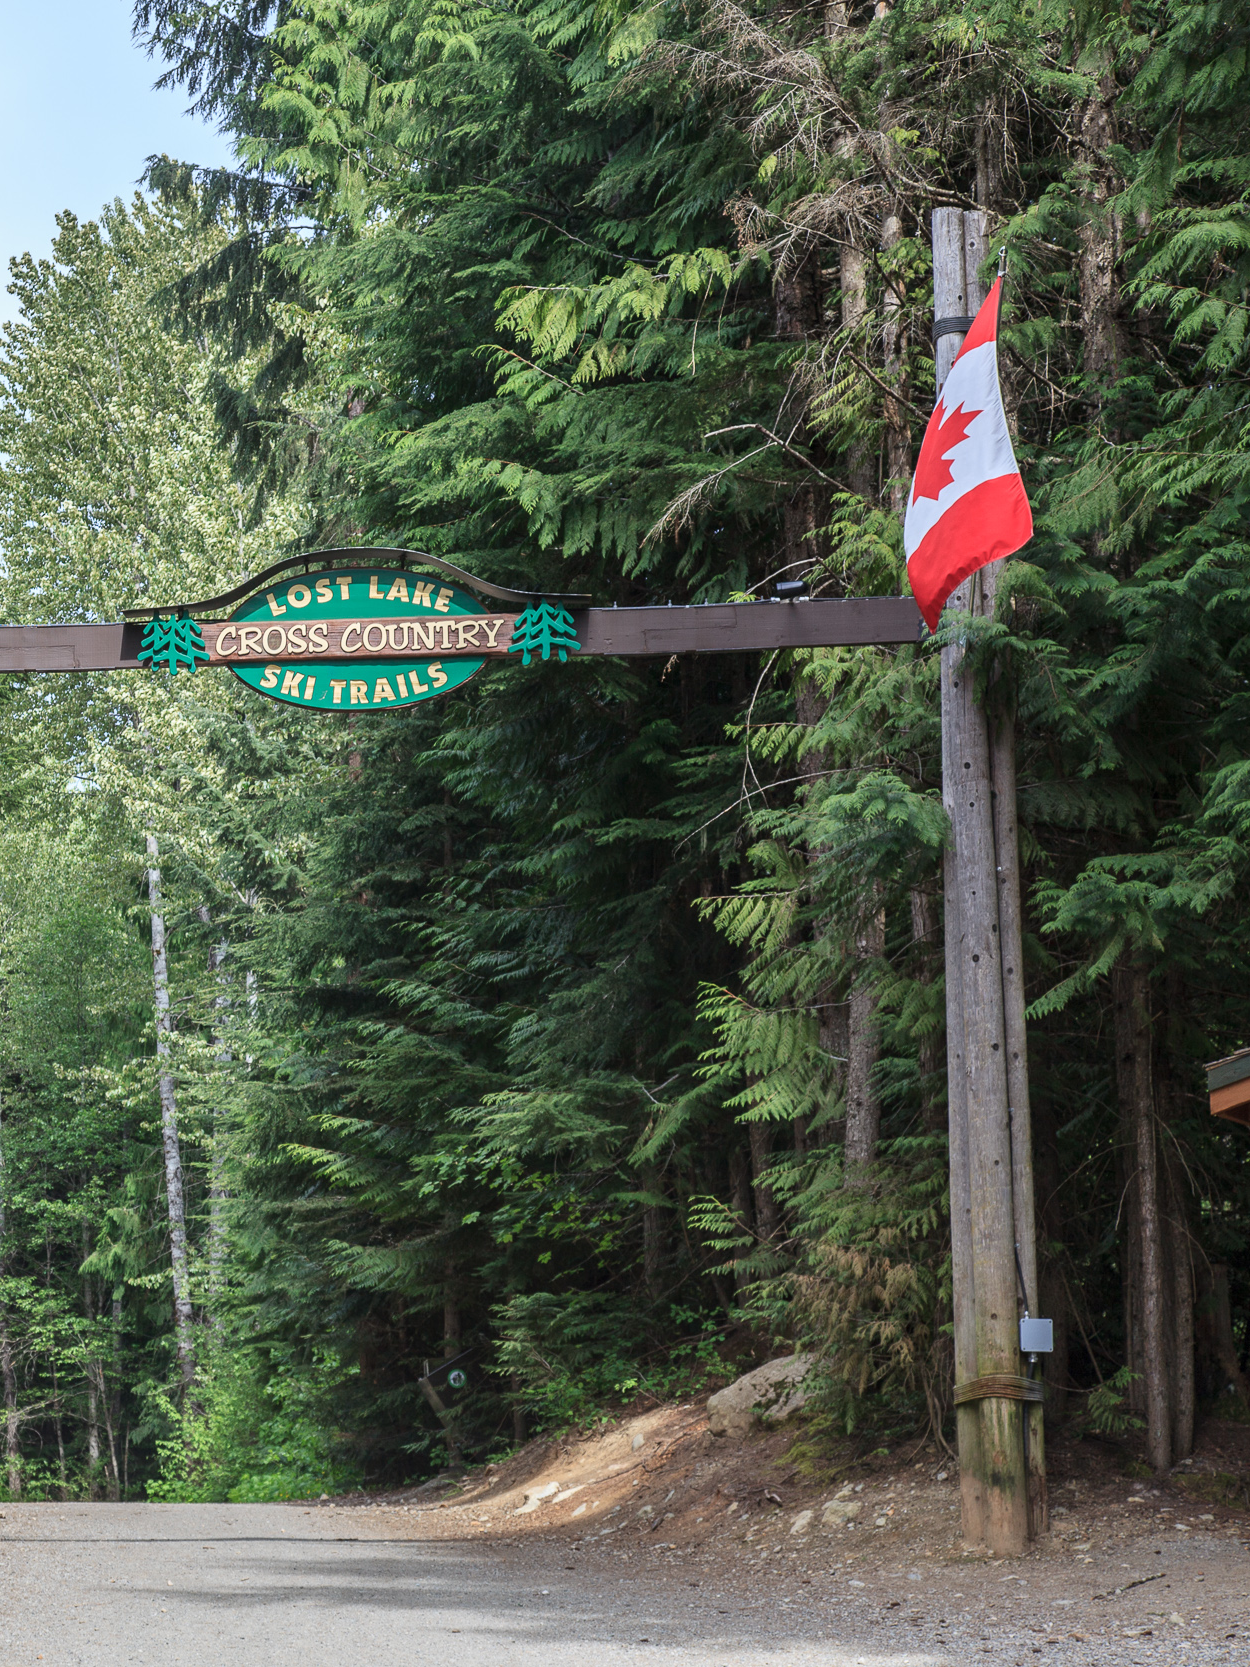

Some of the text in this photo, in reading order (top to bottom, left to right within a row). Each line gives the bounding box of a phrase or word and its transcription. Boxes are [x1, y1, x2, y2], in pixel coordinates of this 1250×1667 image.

[266, 575, 454, 617] LOST LAKE
[215, 619, 504, 656] CROSS COUNTRY
[260, 661, 448, 705] SKI TRAILS
